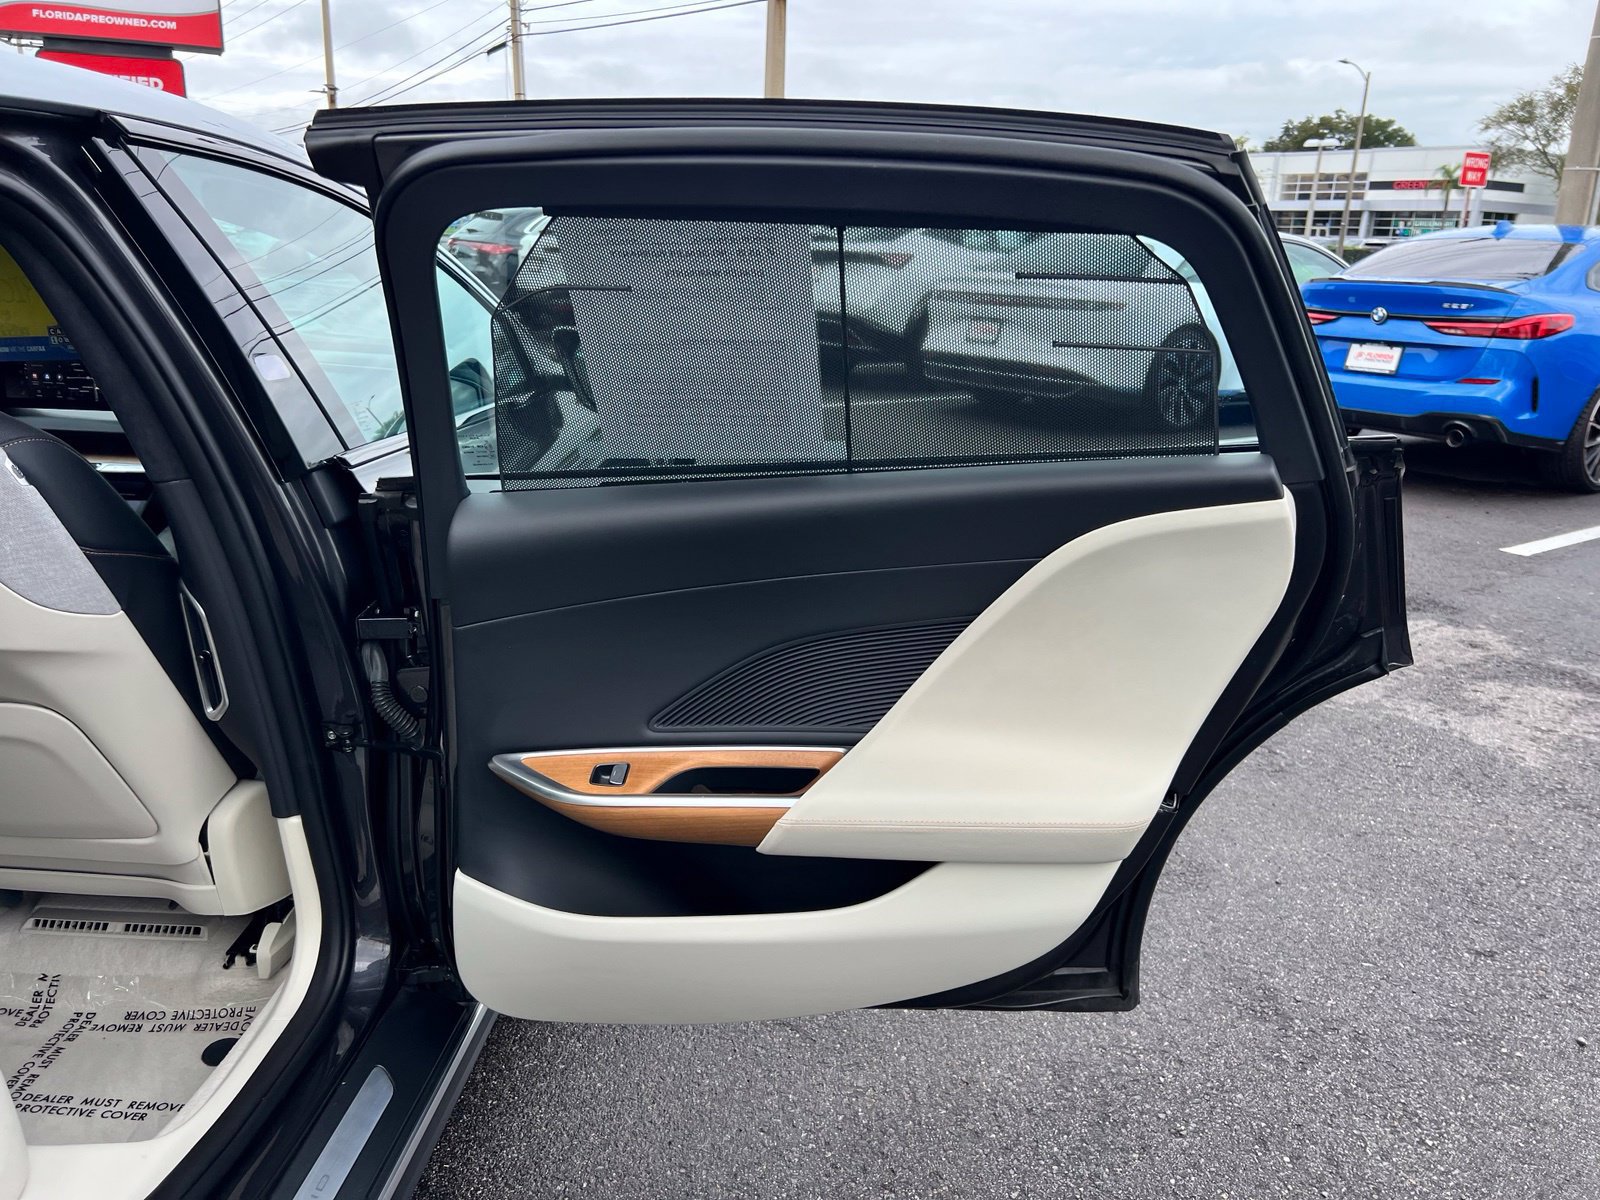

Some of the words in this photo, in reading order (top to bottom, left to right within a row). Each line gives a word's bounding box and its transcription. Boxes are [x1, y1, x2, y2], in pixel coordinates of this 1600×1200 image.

[32, 8, 177, 30] FLORIDAPREOWNED.COM
[1467, 158, 1489, 169] WRONG
[1466, 172, 1483, 181] WAY
[15, 990, 44, 1027] DEALER
[28, 974, 61, 1029] PROTECTI
[0, 1007, 24, 1018] OVE
[124, 1010, 167, 1021] COVER
[171, 1006, 244, 1020] PROTECTIVE
[32, 1012, 83, 1058] PROTECTIVE
[62, 1012, 97, 1042] DEALER
[88, 1023, 144, 1033] REMOVE
[148, 1023, 187, 1033] MUST
[193, 1021, 240, 1032] DEALER
[38, 1046, 66, 1069] MUST
[10, 1073, 40, 1101] REMO
[22, 1092, 74, 1105] DEALER
[80, 1097, 123, 1109] MUST
[15, 1103, 97, 1118] PROTECTIVE
[100, 1109, 148, 1122] COVER
